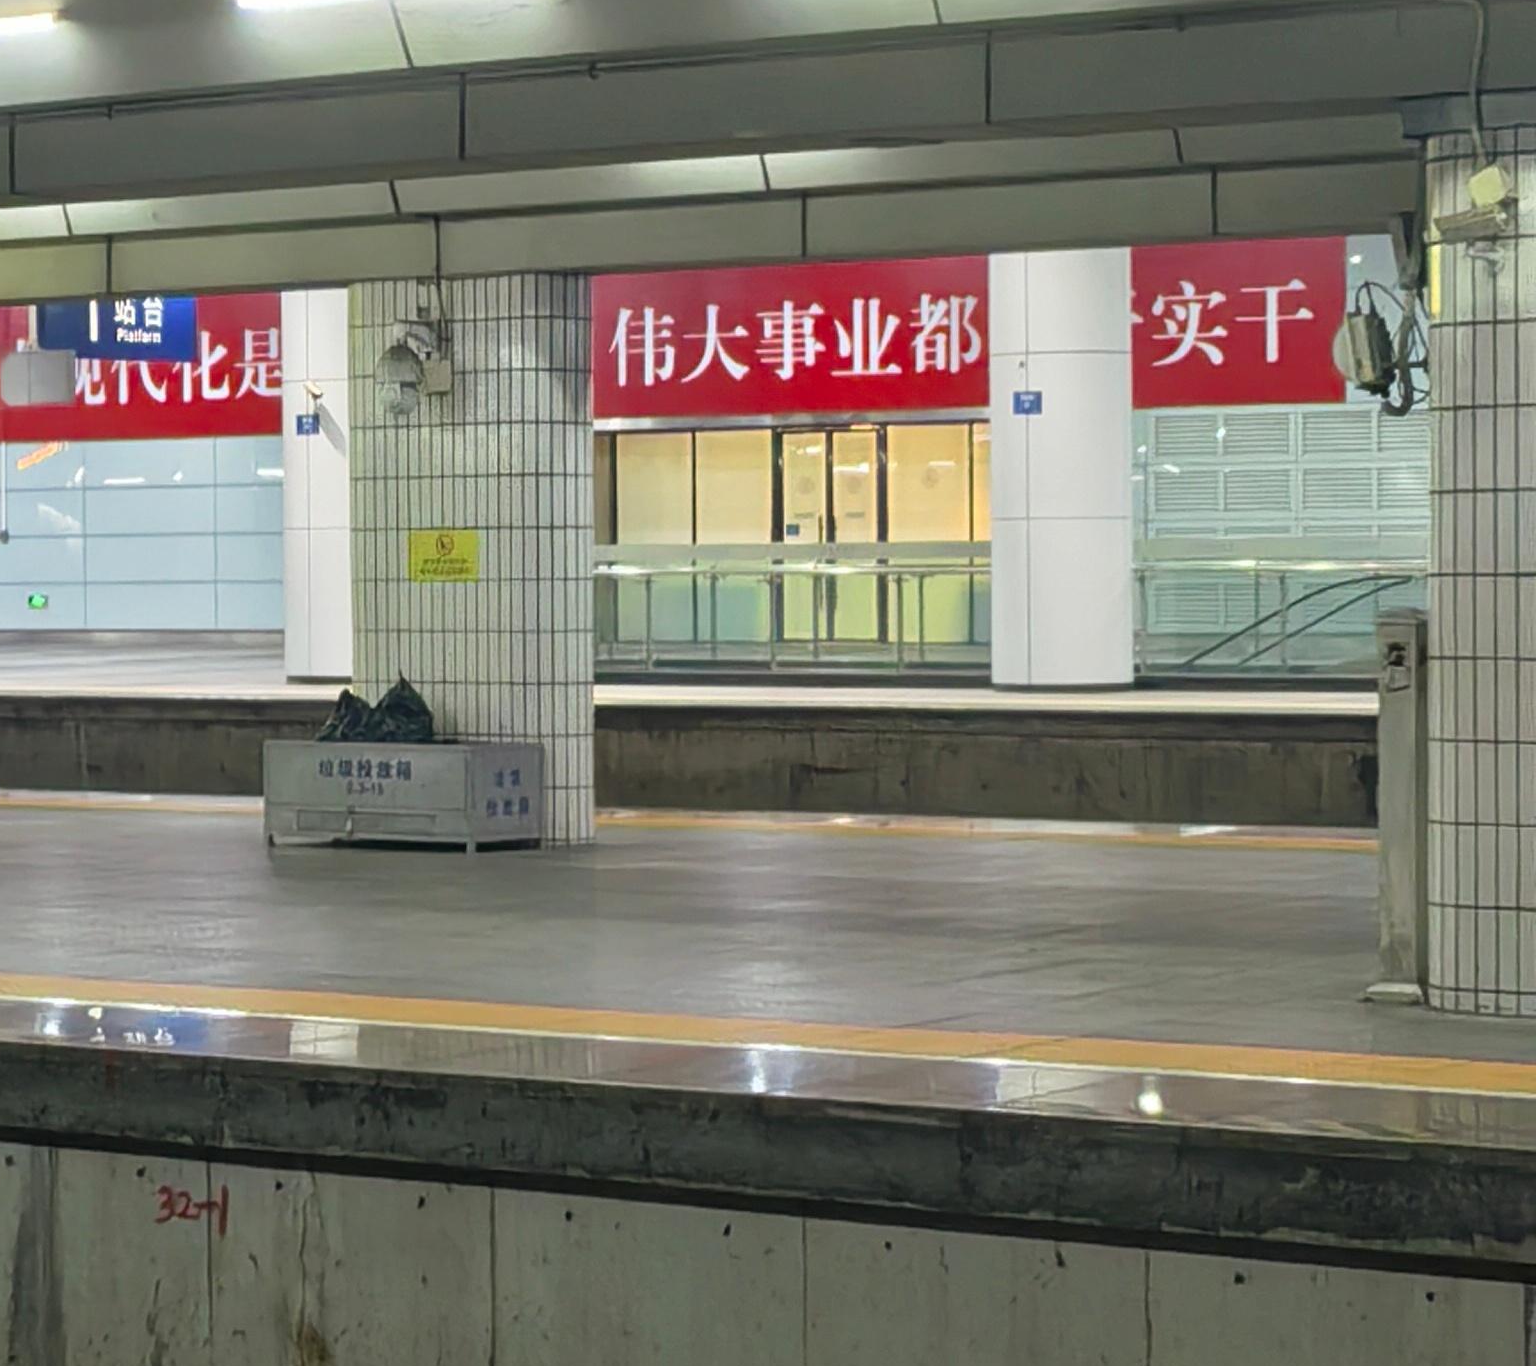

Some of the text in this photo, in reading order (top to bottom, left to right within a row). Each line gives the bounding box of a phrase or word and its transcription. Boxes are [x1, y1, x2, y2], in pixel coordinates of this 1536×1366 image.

[114, 296, 163, 327] 站台
[116, 327, 162, 343] Platform
[1131, 278, 1314, 367] 实干
[609, 293, 982, 387] 伟大事业都
[154, 1184, 230, 1239] 32-1
